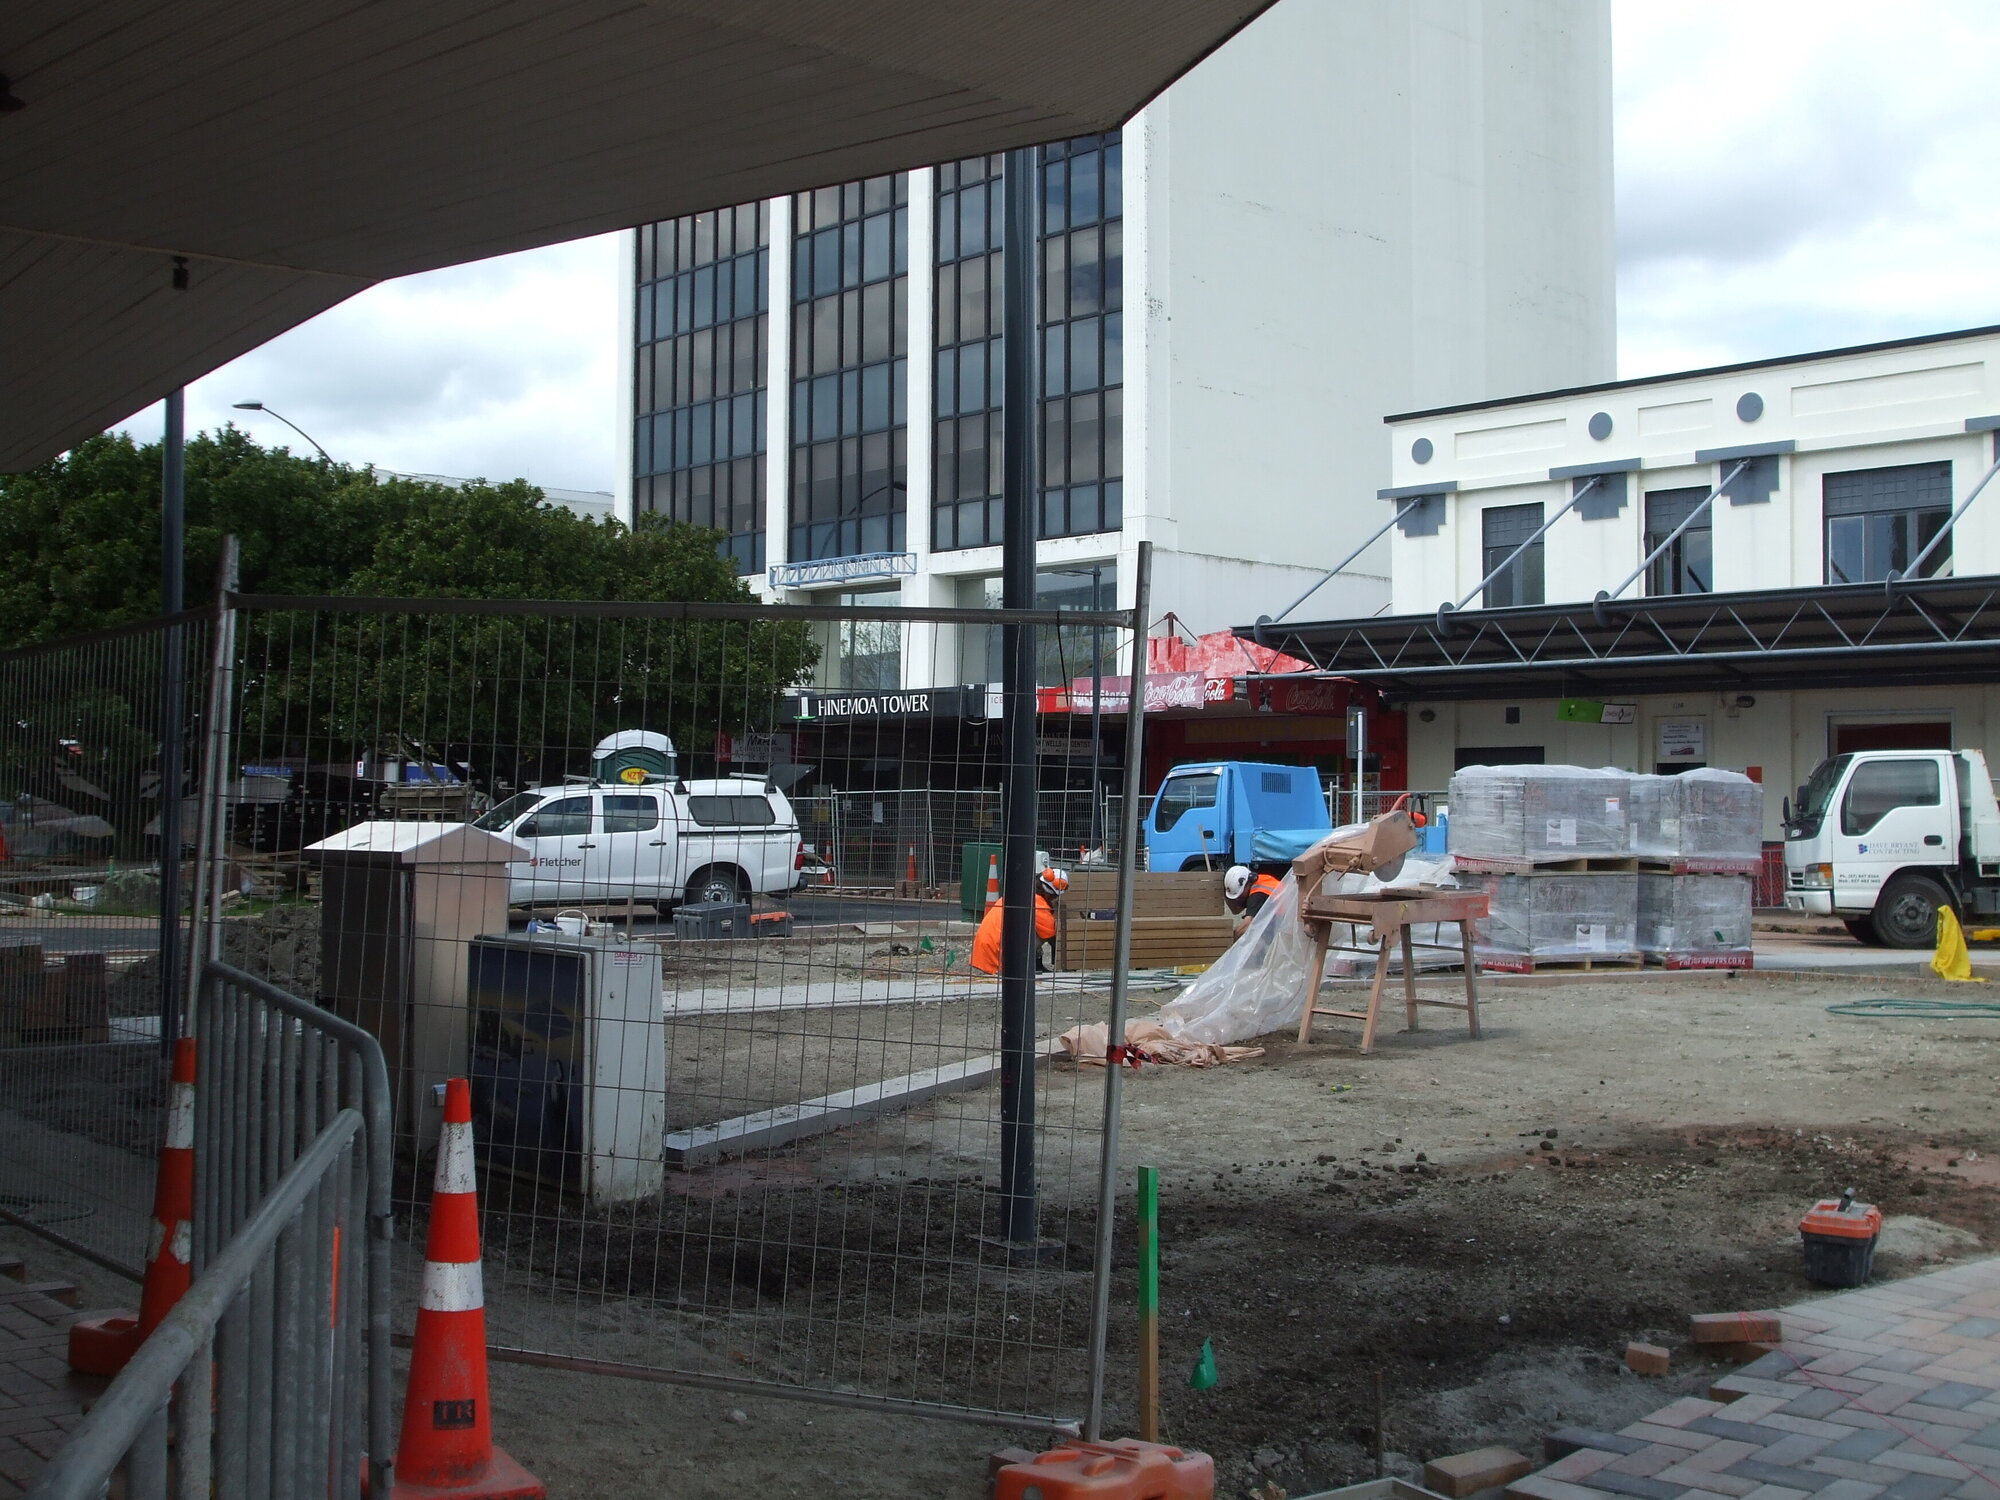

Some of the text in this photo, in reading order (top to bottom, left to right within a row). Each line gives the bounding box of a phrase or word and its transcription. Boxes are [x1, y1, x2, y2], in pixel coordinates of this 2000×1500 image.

[818, 694, 929, 716] HINEMOA TOWER
[539, 857, 582, 867] Fletcher
